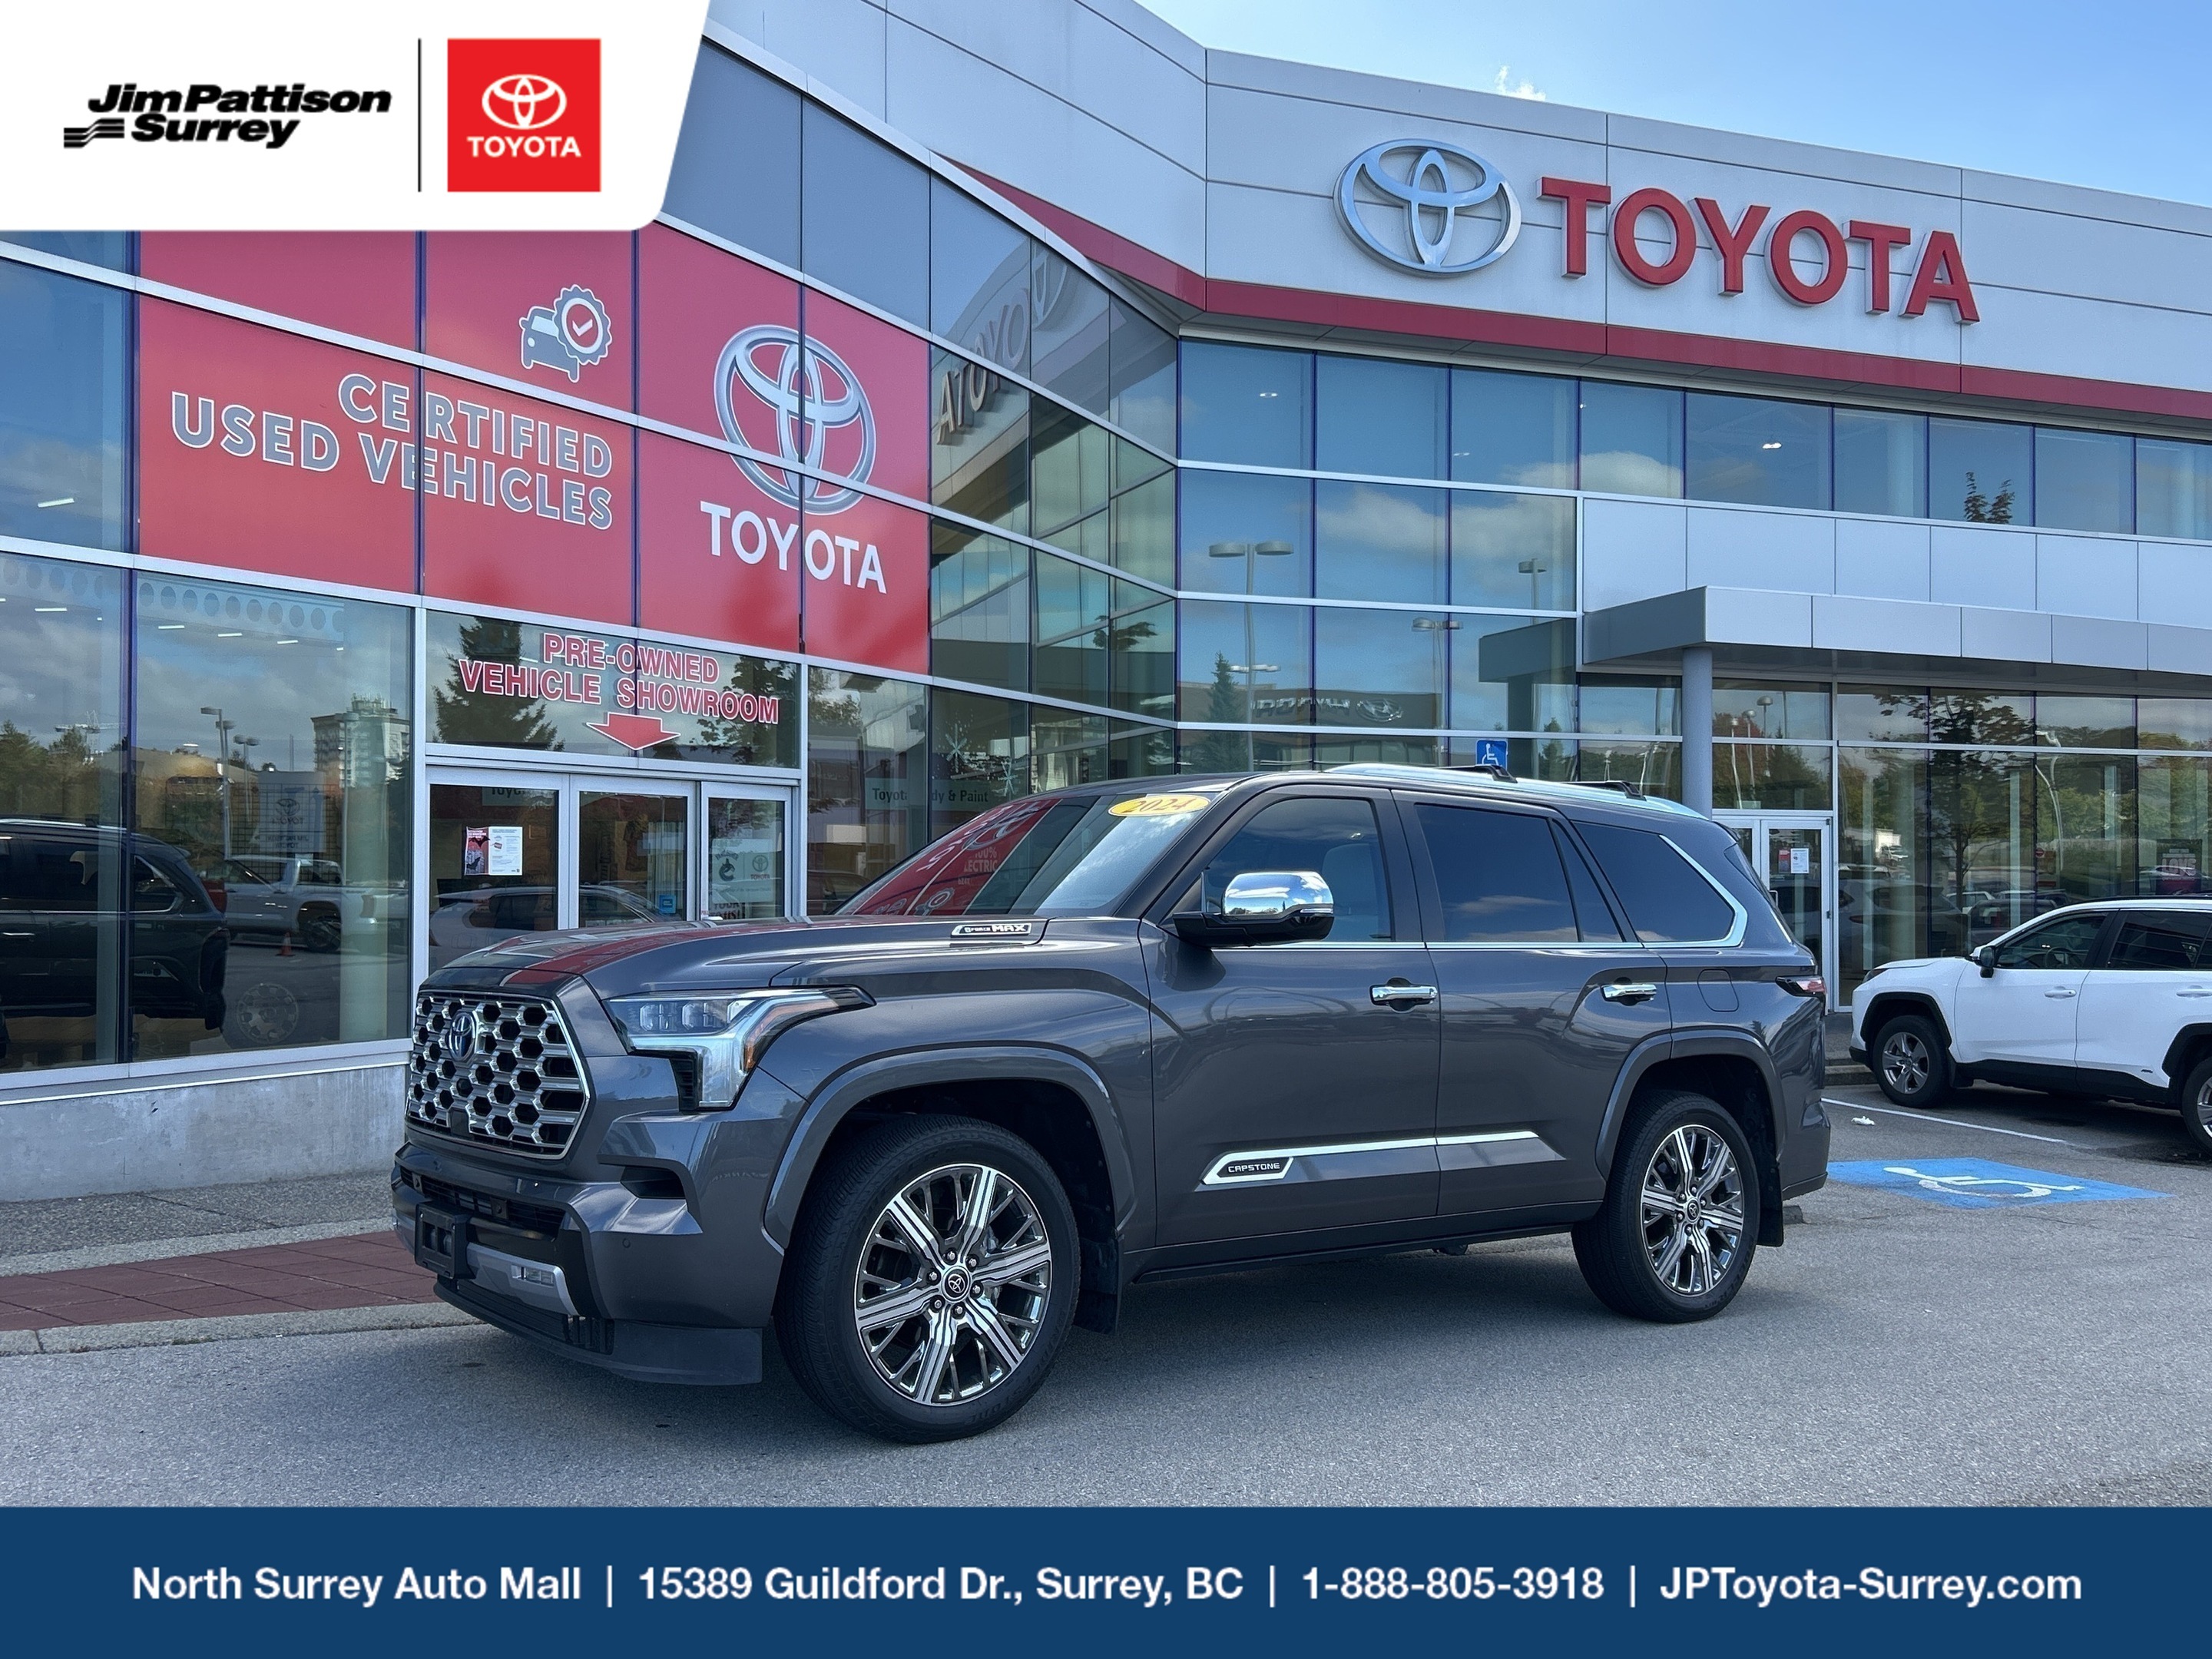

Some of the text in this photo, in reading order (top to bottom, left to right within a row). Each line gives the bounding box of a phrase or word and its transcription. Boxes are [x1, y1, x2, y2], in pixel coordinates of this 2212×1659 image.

[1536, 175, 1981, 326] TOYOTA
[336, 373, 613, 479] CERTIFIED
[171, 392, 613, 531] USED VEHICLES
[700, 500, 887, 594] TOYOTA
[542, 632, 720, 684] PRE-OWNED
[459, 659, 780, 725] VEHICLE SHOWROOM
[948, 790, 957, 802] &
[960, 790, 989, 803] Paint
[1121, 798, 1198, 813] 2024
[992, 924, 1027, 933] MAX
[1227, 1162, 1281, 1173] CAPSTONE
